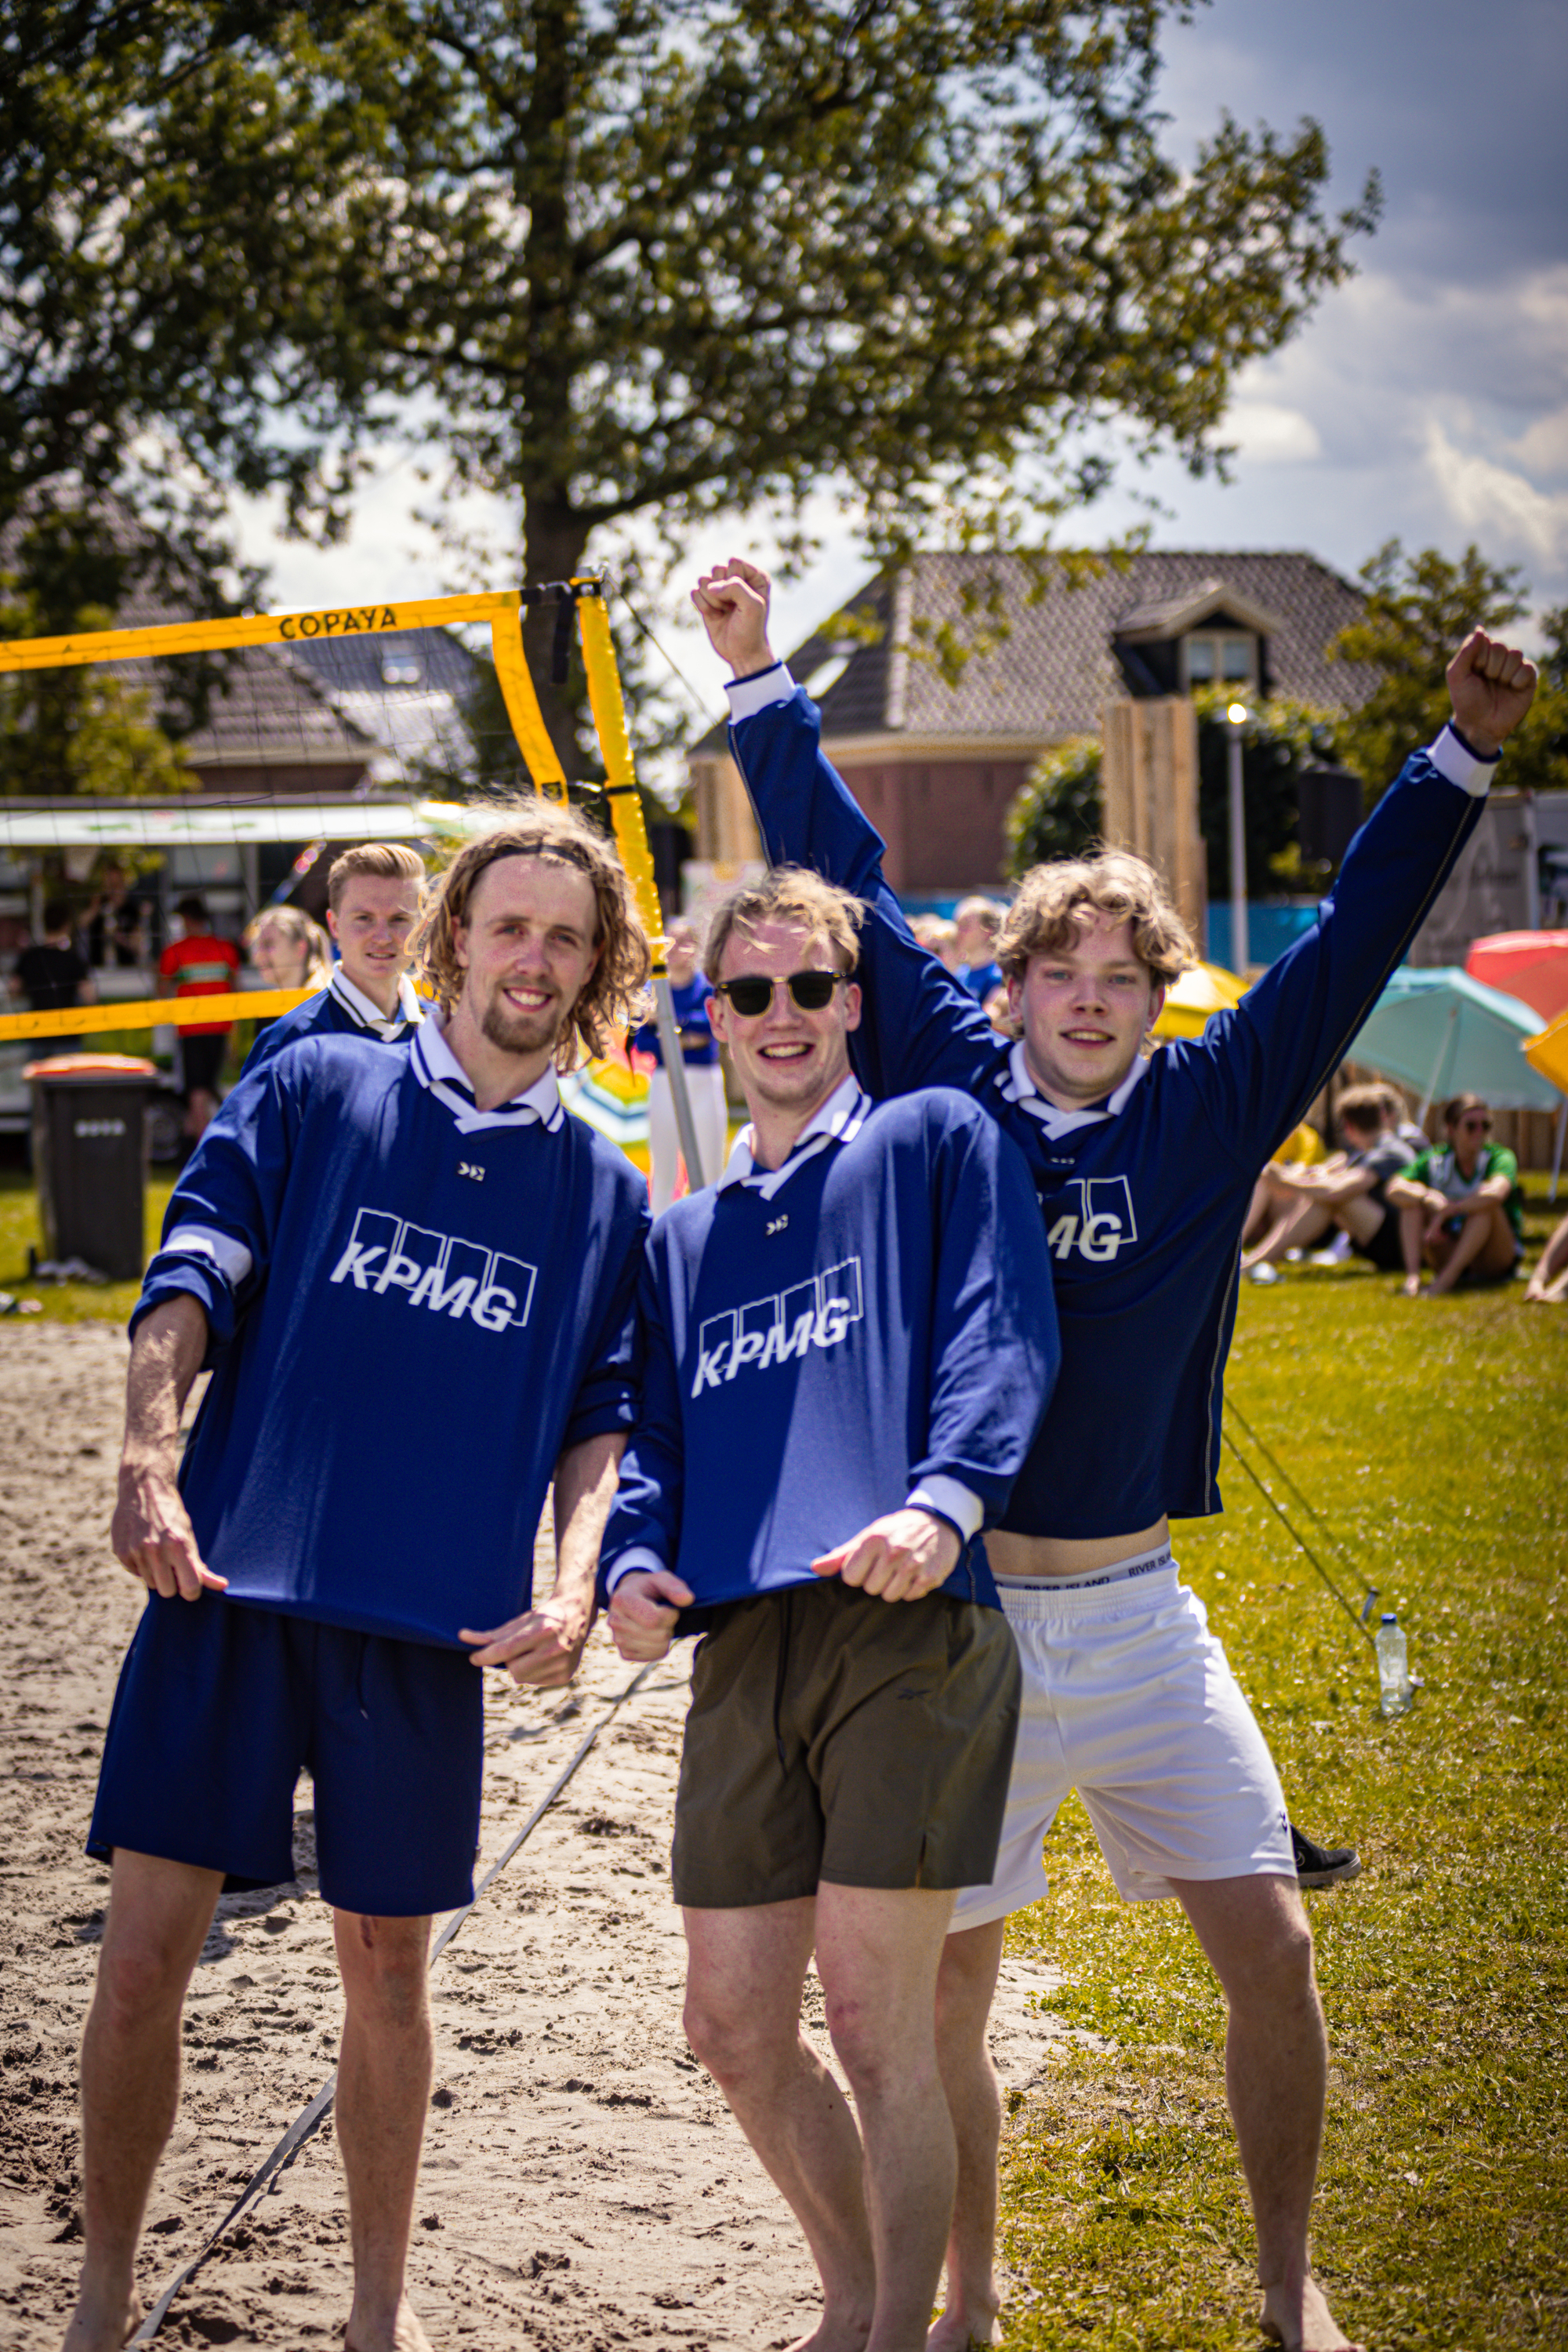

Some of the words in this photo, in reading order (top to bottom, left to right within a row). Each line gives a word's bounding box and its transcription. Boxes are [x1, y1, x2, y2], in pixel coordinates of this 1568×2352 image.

[279, 607, 397, 639] COPAYA
[329, 1242, 517, 1332] KPMG
[691, 1297, 850, 1399] KPMG
[1128, 1559, 1156, 1577] RIVER
